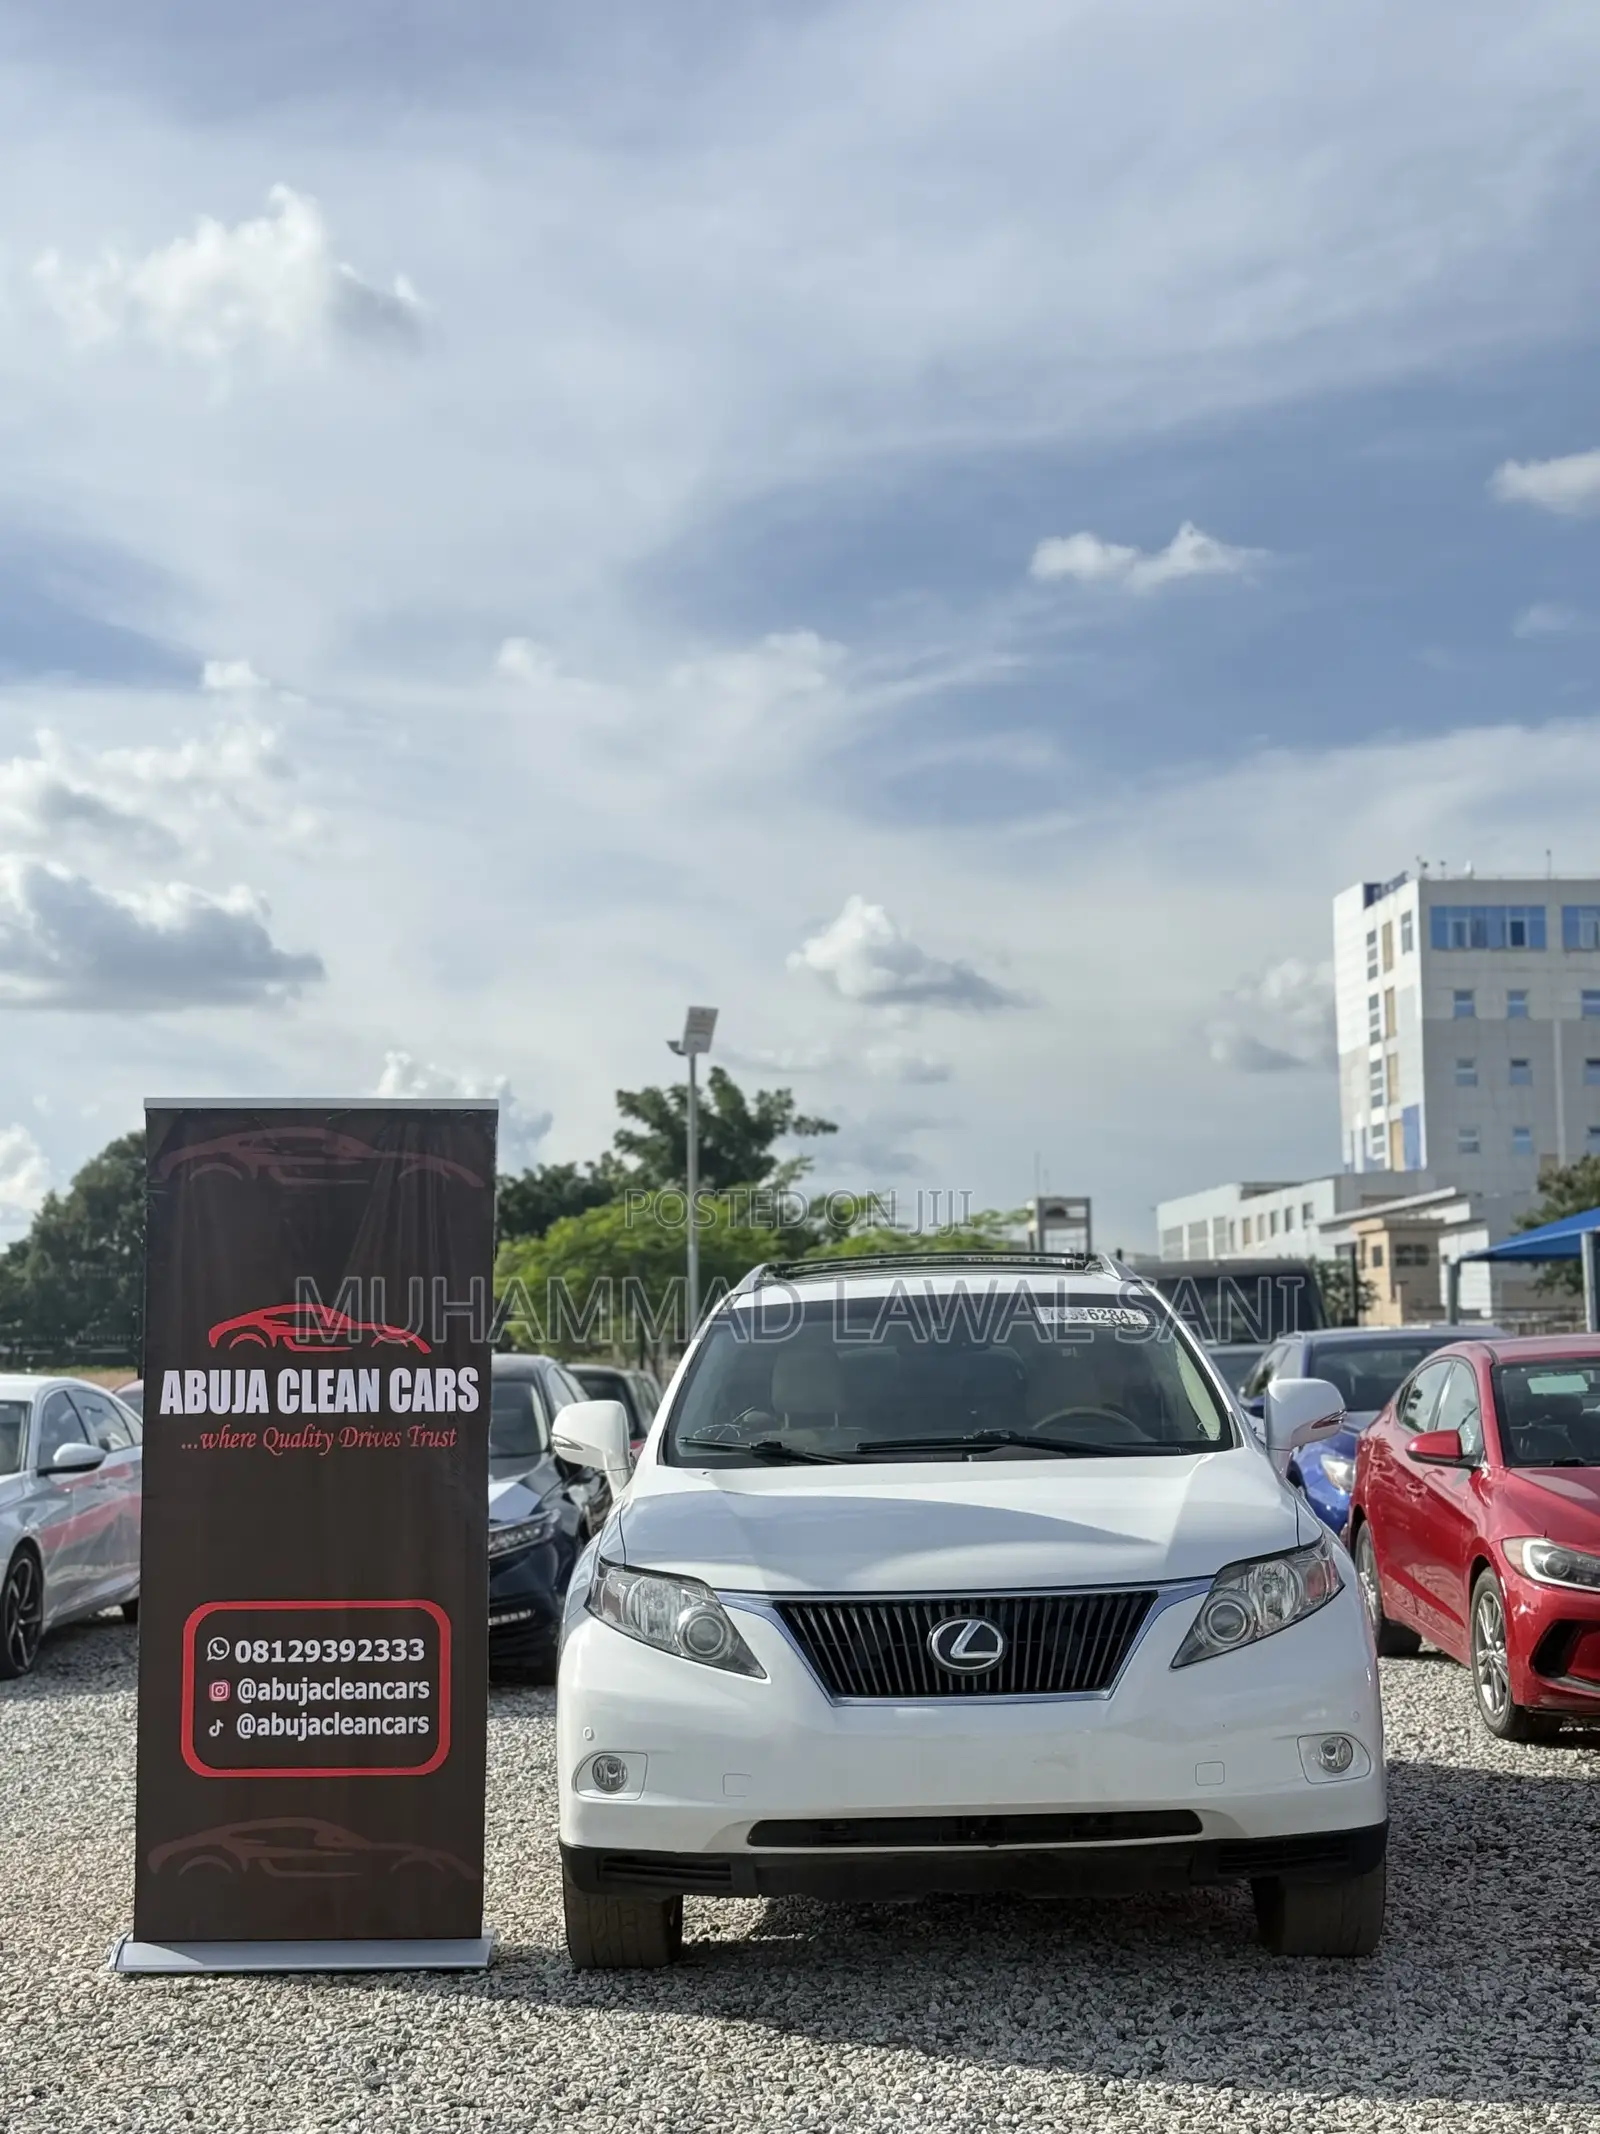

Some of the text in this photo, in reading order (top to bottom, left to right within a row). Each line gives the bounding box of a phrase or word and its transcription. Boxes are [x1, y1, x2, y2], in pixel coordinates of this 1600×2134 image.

[159, 1367, 480, 1415] ABUJA CLEAN CARS
[181, 1423, 457, 1456] ...where Quality Drives Trust
[234, 1638, 425, 1663] 08129392333
[237, 1676, 430, 1706] @abujacleancars
[236, 1712, 430, 1741] @abujacleancars
